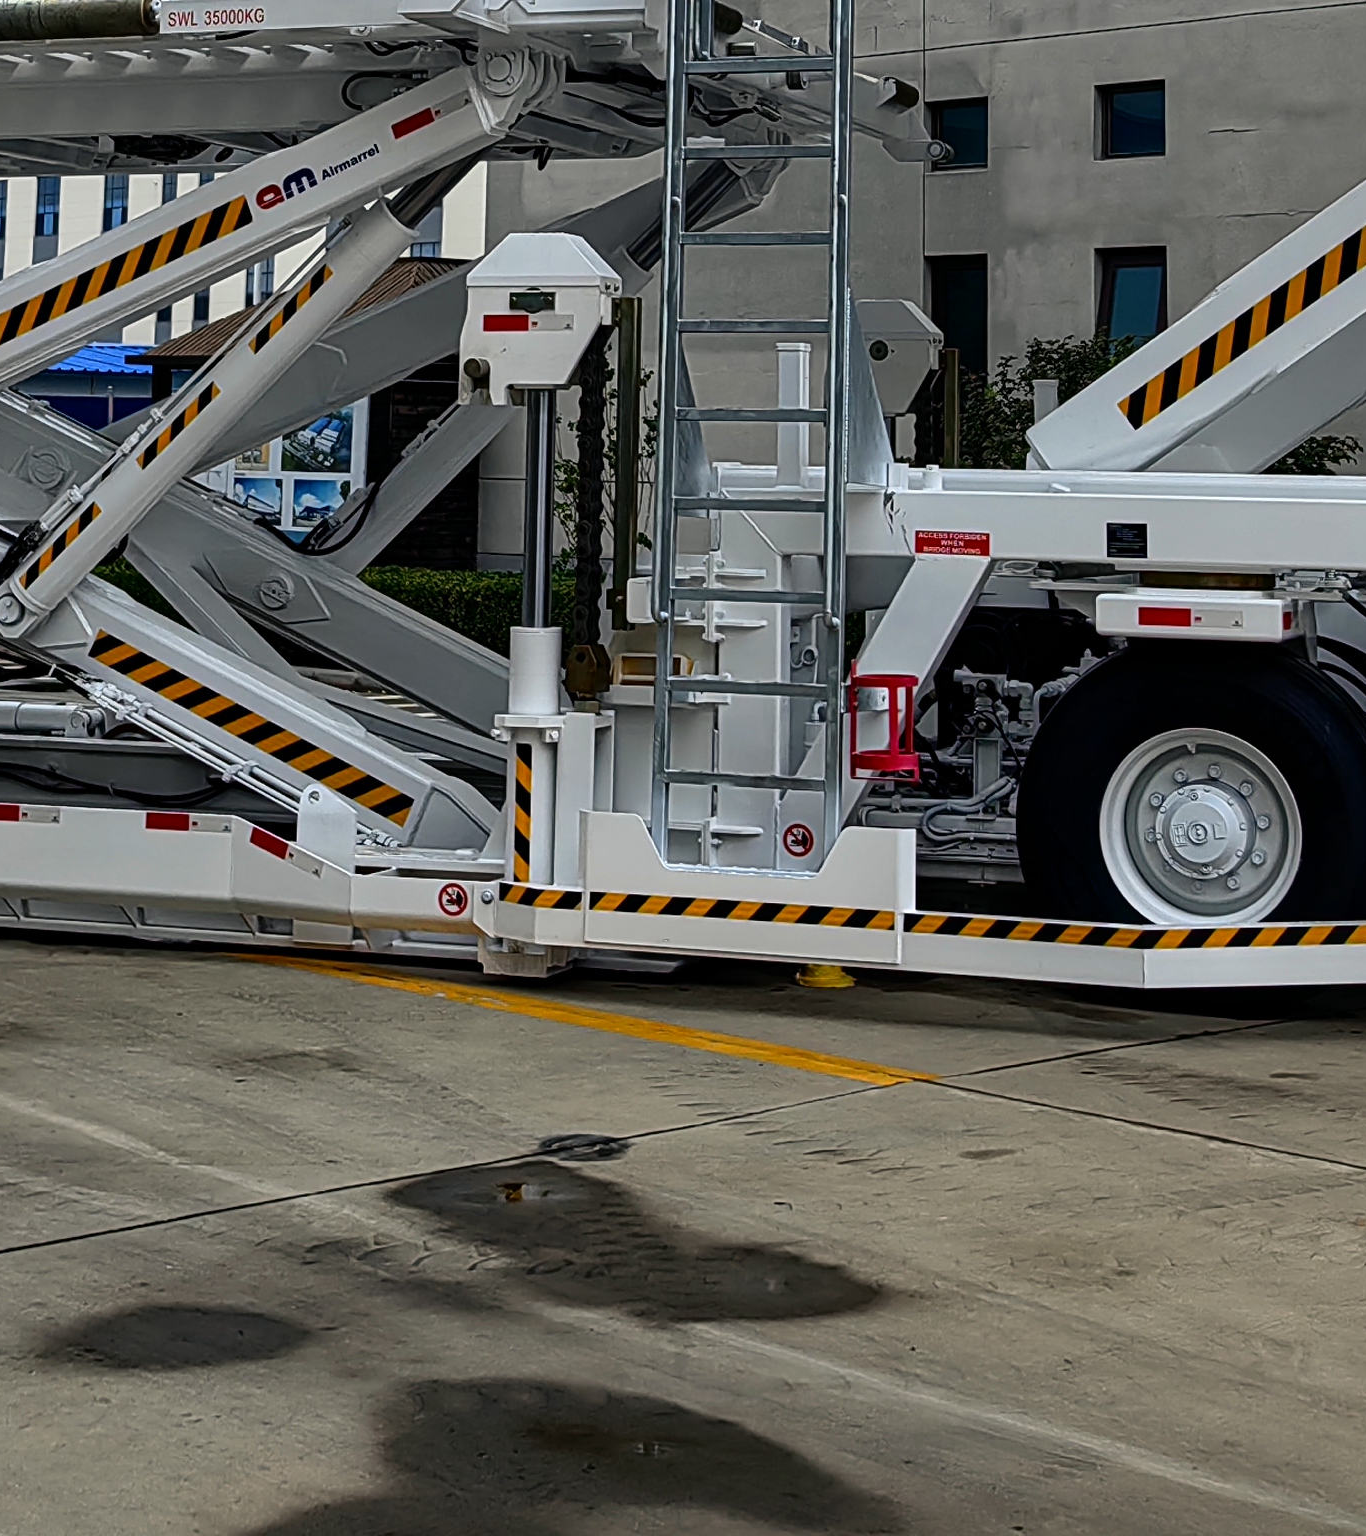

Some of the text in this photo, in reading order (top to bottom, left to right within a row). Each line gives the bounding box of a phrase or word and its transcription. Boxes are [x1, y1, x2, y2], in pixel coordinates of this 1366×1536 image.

[168, 8, 265, 27] SWL 35000KG
[322, 143, 380, 181] Airmarrel
[940, 539, 965, 547] WHEN
[951, 547, 981, 555] MOVING
